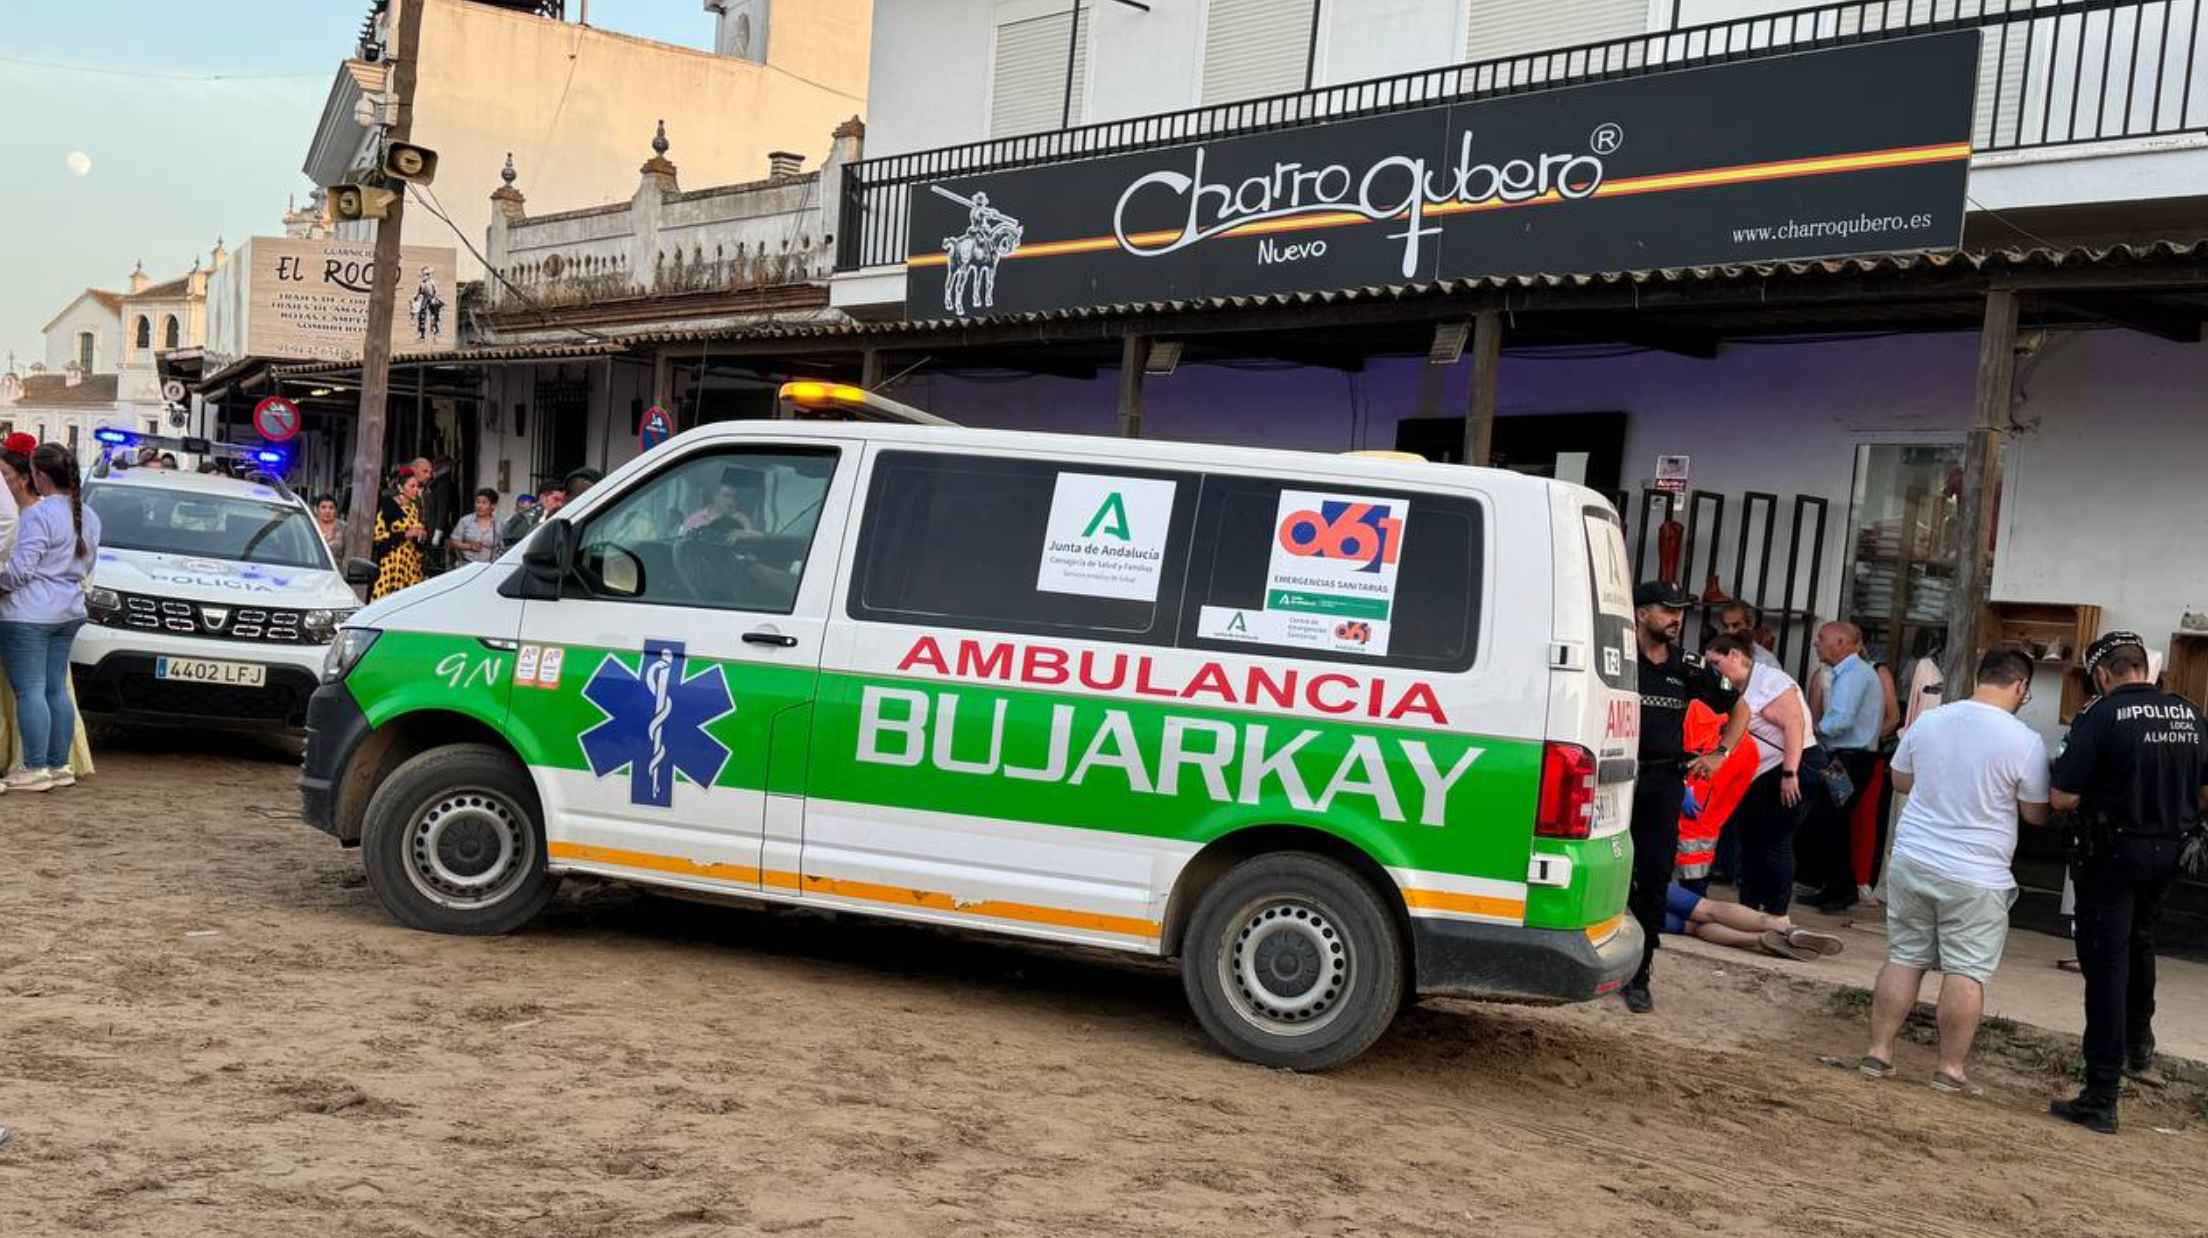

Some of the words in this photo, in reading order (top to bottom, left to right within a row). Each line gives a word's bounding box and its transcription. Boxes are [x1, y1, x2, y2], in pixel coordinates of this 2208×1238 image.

[1114, 147, 1351, 257] Charro
[1732, 213, 1932, 243] www.charroqubero.es
[1258, 238, 1326, 265] Nuevo
[275, 256, 303, 281] EL
[1049, 540, 1083, 554] Junta
[1084, 543, 1099, 555] de
[1274, 575, 1335, 590] EMERGENCIAS
[1337, 580, 1388, 593] SANITARIAS
[170, 660, 219, 681] 4402
[225, 664, 262, 684] LFJ
[897, 635, 1448, 725] AMBULANCIA
[2144, 731, 2199, 744] ALMONTE
[2169, 721, 2195, 731] LOCAL
[856, 685, 1486, 827] BUJARKAY
